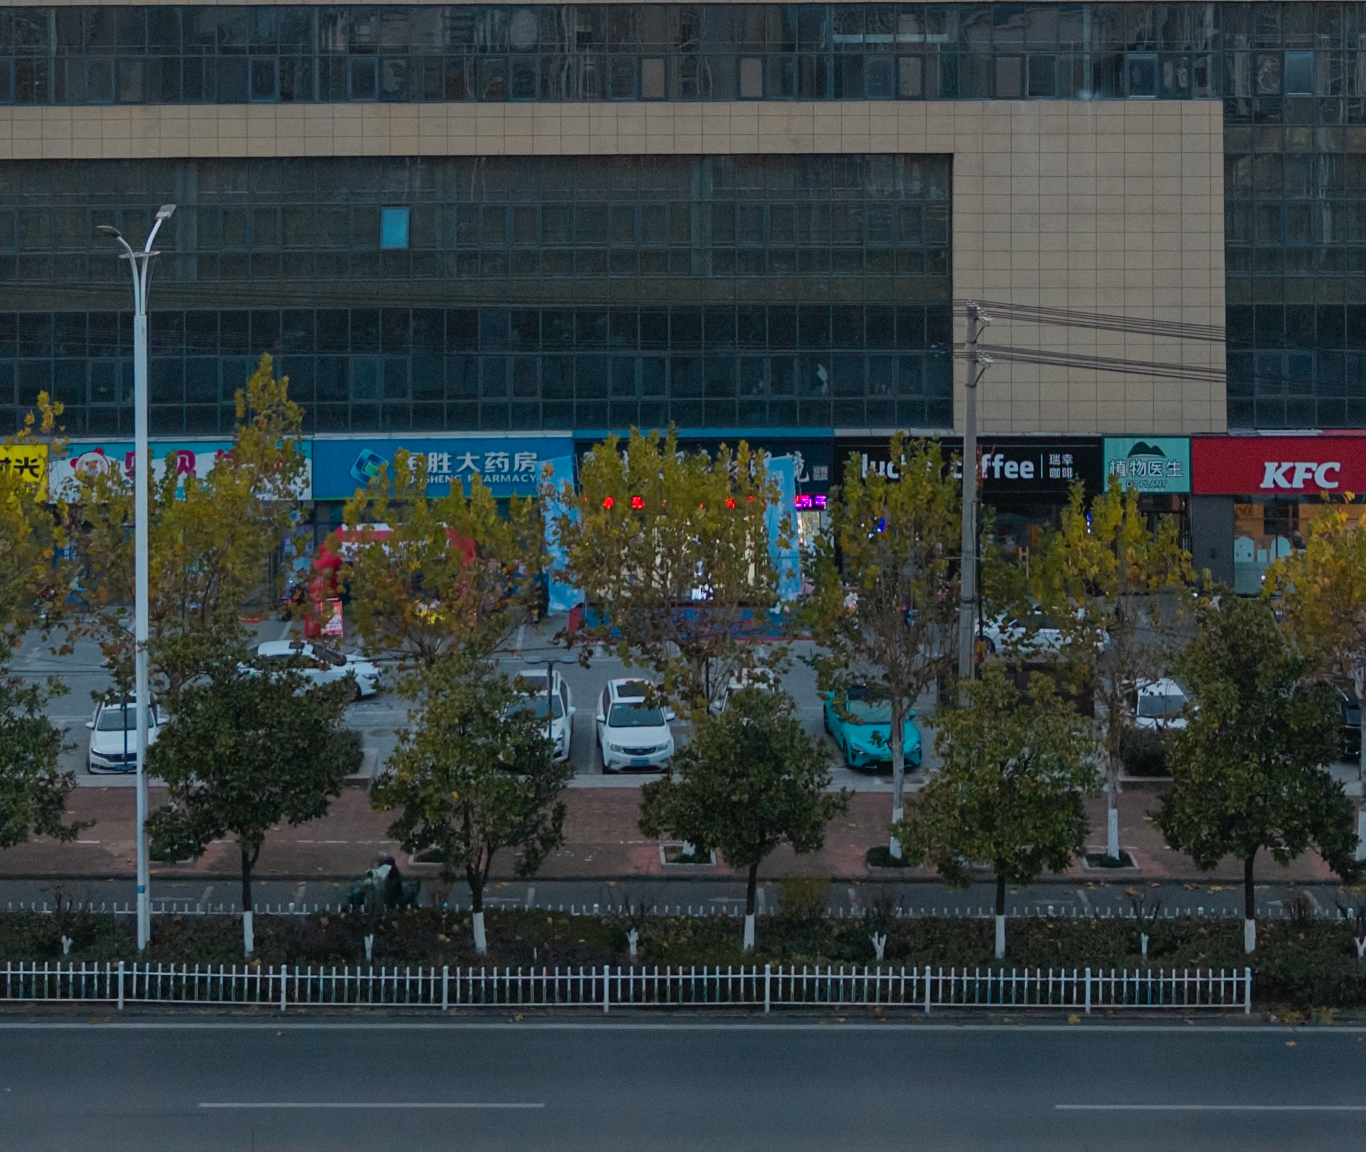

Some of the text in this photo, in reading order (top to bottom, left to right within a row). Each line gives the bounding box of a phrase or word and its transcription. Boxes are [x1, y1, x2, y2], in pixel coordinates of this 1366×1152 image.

[1109, 459, 1183, 477] 植物医生
[1260, 461, 1341, 490] KFC
